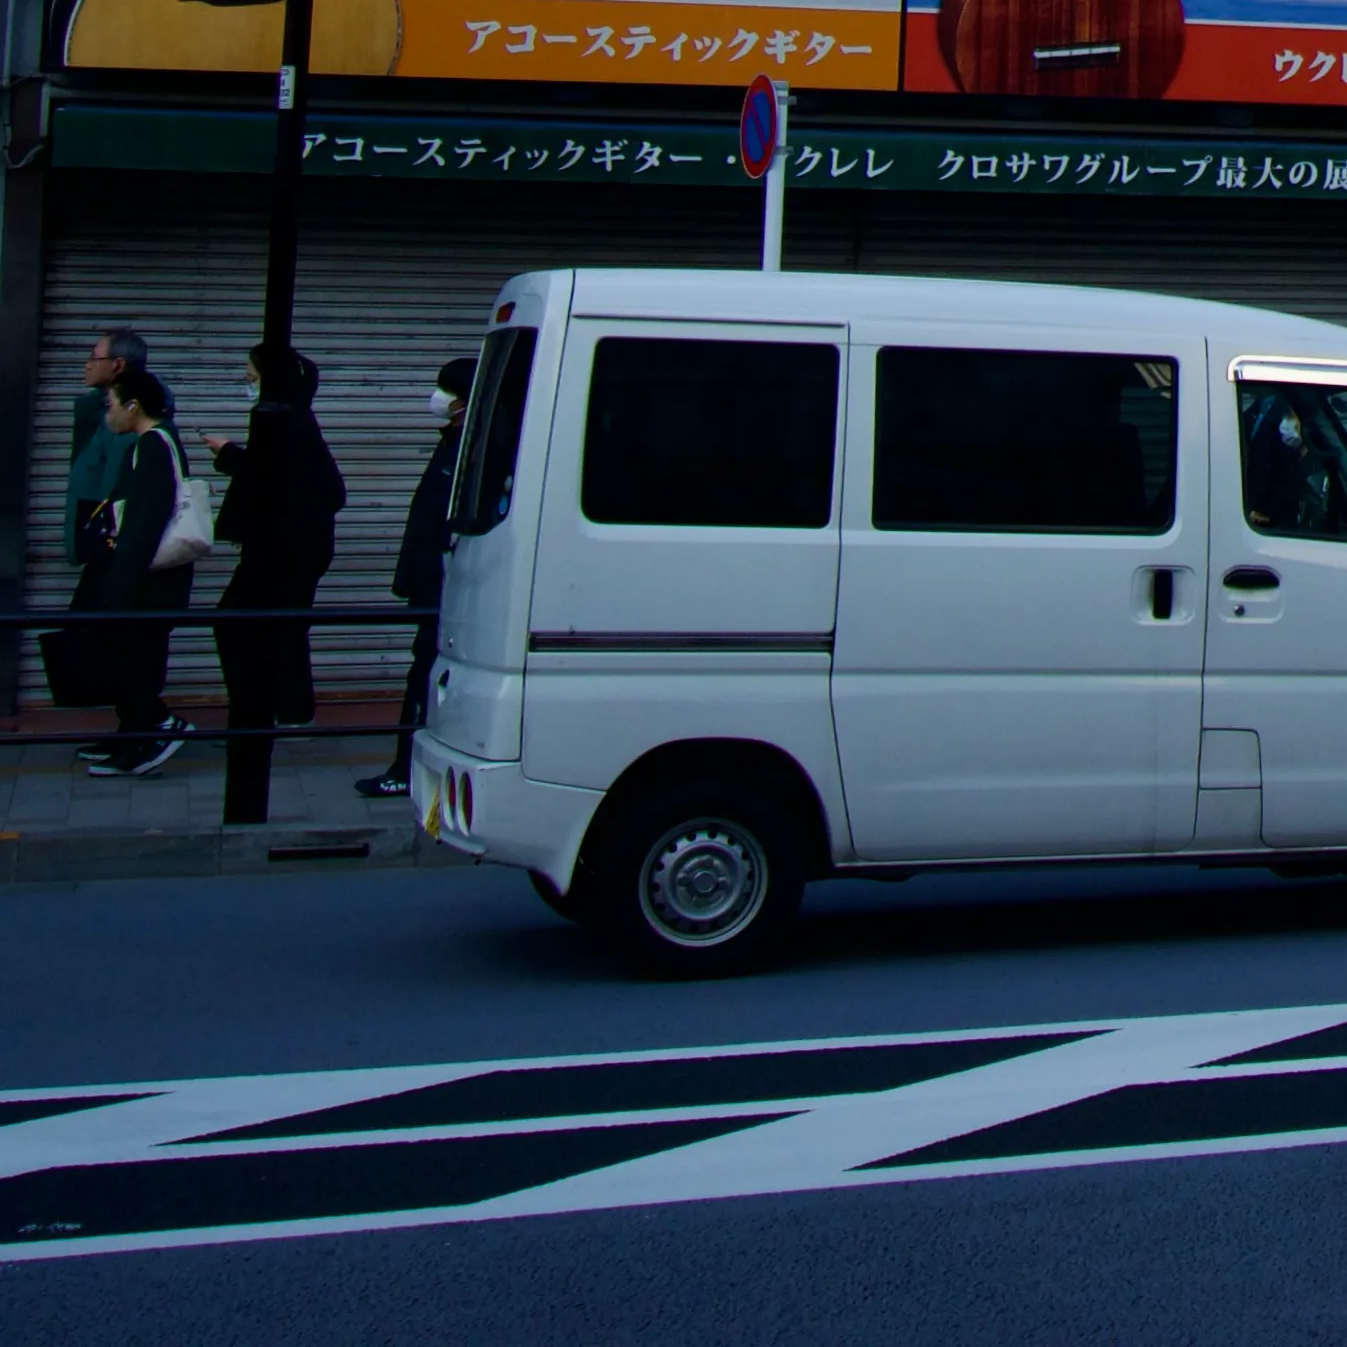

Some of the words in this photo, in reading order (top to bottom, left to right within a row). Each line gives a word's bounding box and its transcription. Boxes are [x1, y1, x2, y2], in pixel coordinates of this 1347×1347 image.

[464, 18, 874, 66] アコースティックギター
